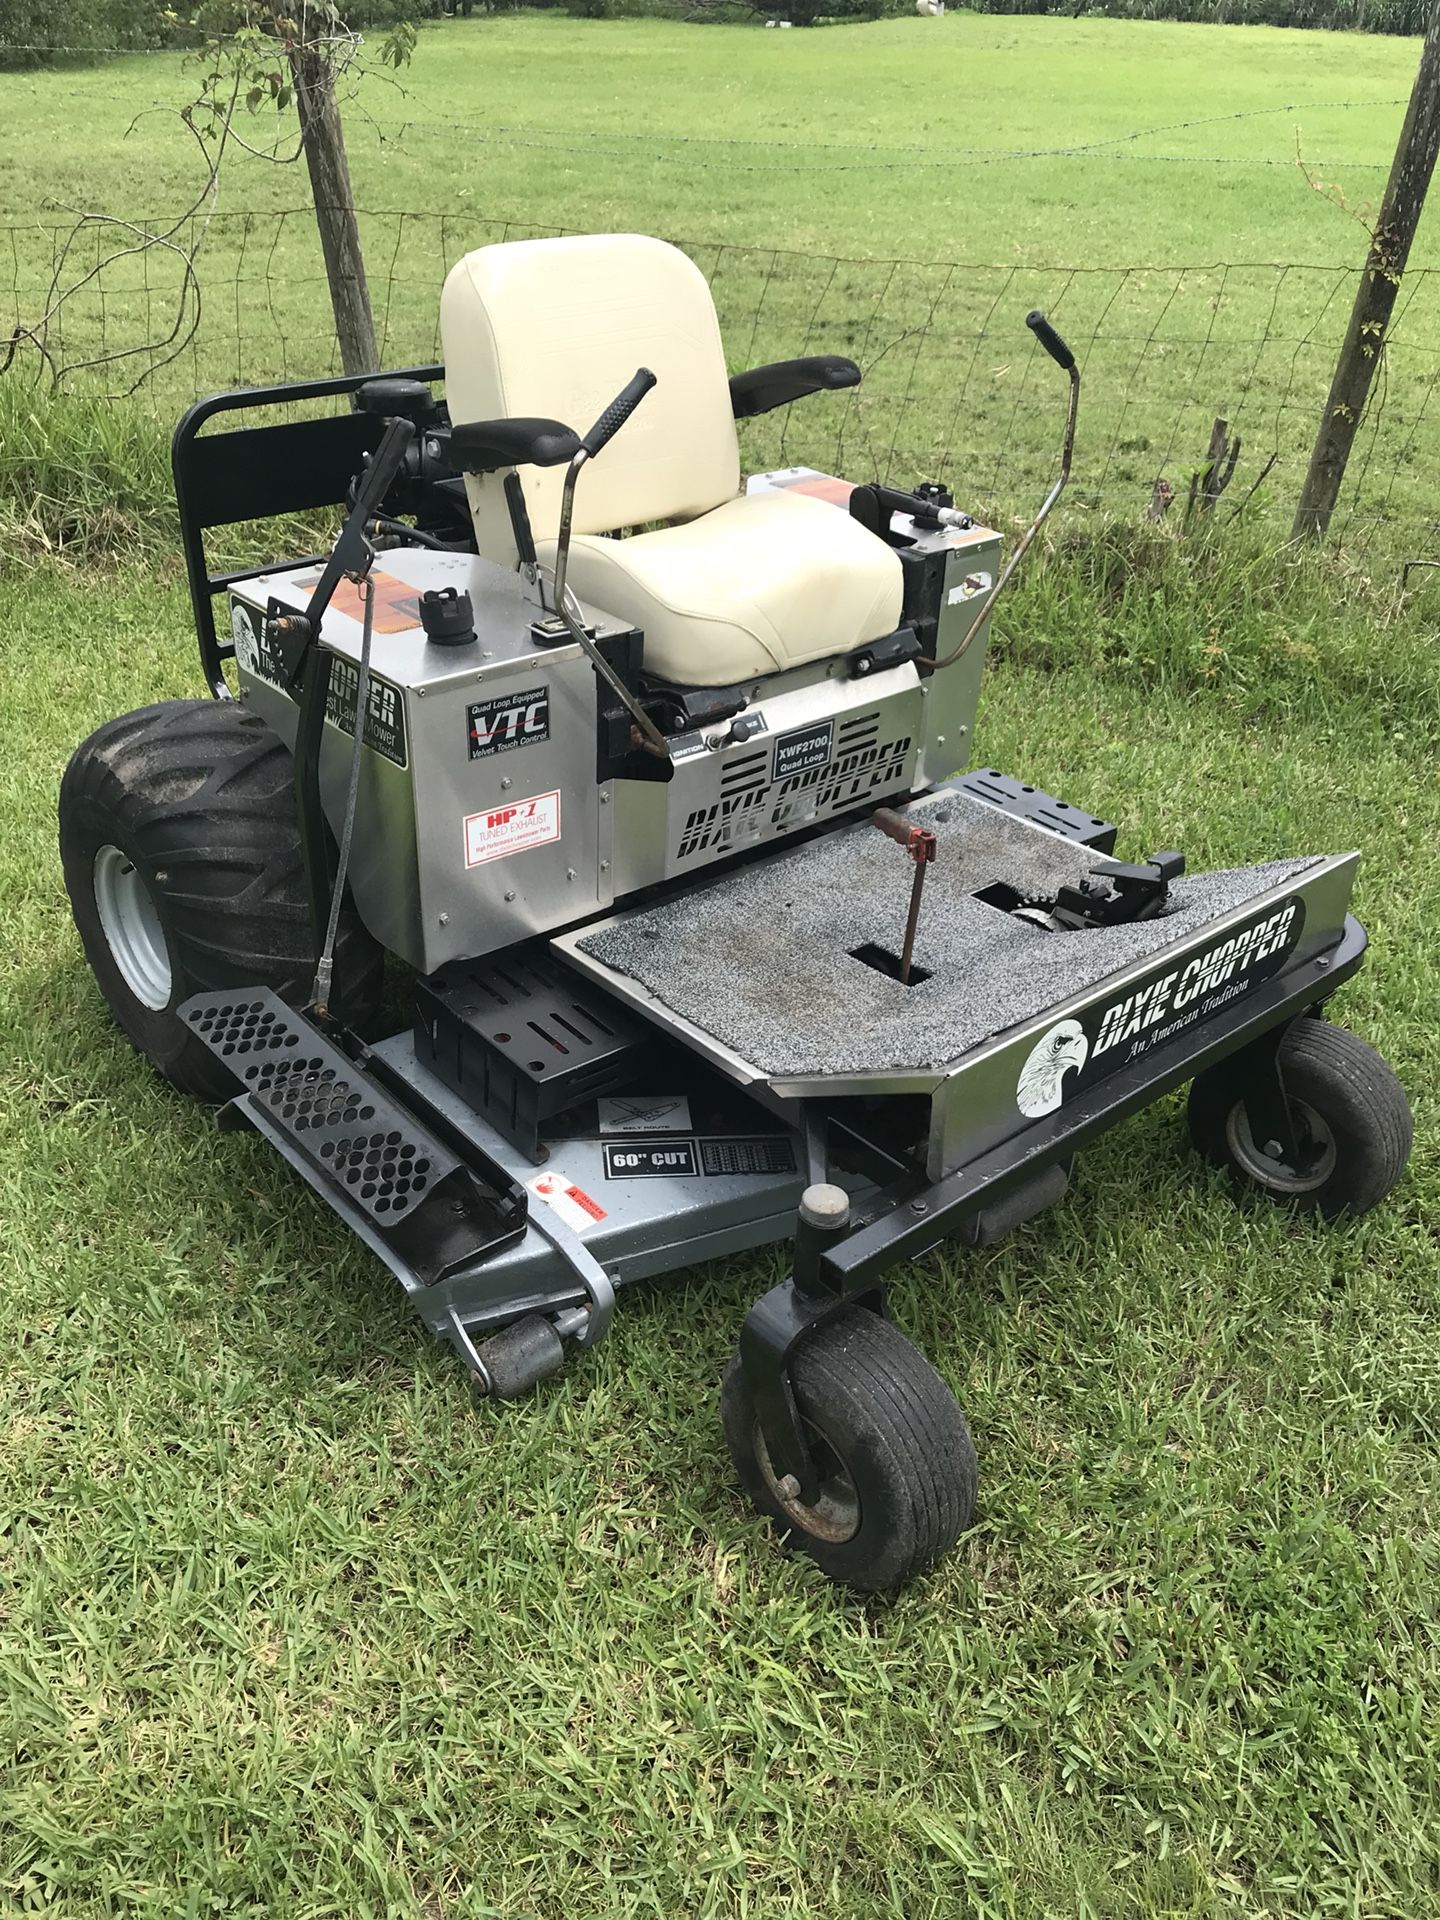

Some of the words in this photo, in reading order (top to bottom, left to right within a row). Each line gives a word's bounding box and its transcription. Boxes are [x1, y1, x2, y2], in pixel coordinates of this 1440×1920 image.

[260, 651, 276, 673] The
[471, 702, 492, 714] Quad
[492, 699, 511, 710] Loop
[512, 688, 545, 704] Equipped
[474, 700, 548, 746] VTC
[471, 747, 496, 759] Velvet
[497, 740, 519, 752] Touch
[520, 731, 547, 745] Control
[672, 743, 705, 758] IGNITION
[778, 735, 829, 761] XWF2700
[780, 758, 803, 773] Quad
[804, 752, 826, 766] Loop
[479, 825, 509, 842] TUNED
[510, 813, 547, 833] EXHAUST
[487, 809, 517, 829] HP
[1090, 971, 1179, 1059] DIXIE
[1172, 904, 1296, 1010] CHOPPER
[1124, 1039, 1147, 1064] An
[1144, 1010, 1199, 1051] American
[1200, 977, 1250, 1015] Tradition
[651, 1151, 689, 1166] CUT
